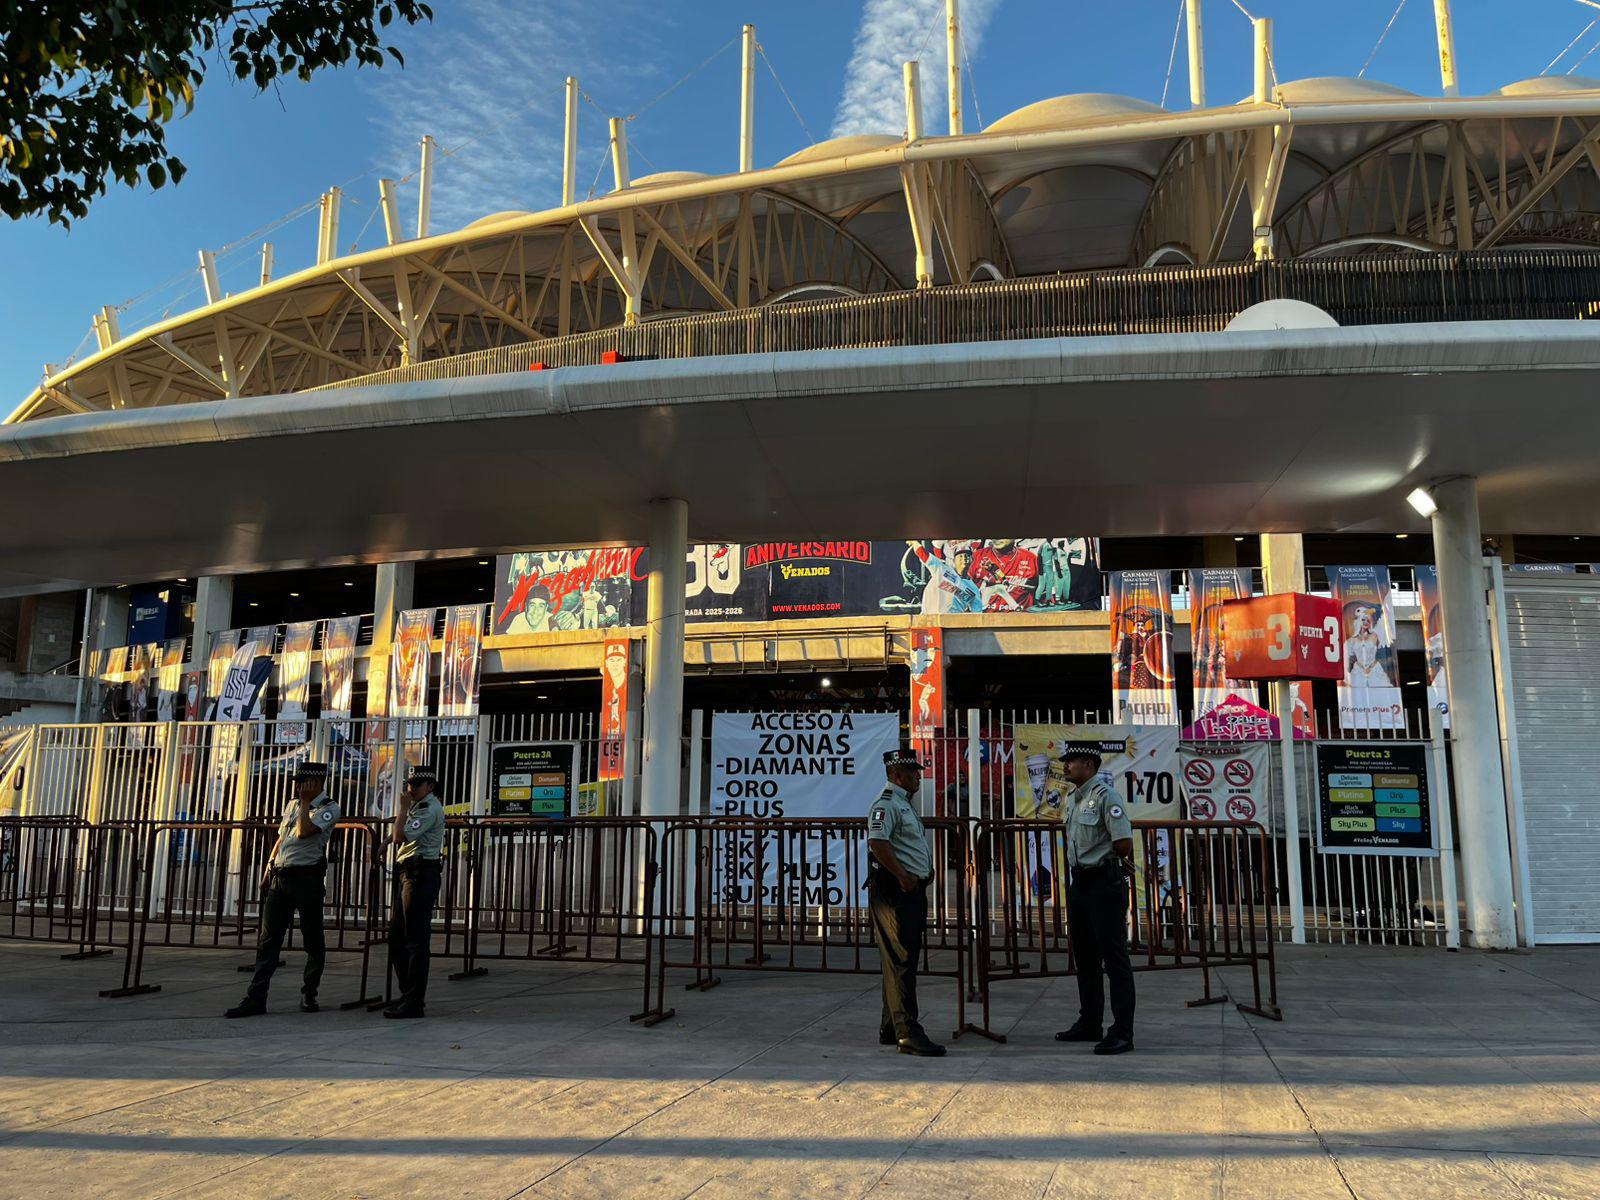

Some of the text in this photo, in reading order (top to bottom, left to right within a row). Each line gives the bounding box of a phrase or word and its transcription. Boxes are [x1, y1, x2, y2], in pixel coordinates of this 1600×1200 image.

[746, 541, 869, 567] ANIVERSARIO
[1121, 570, 1157, 578] CARNAVAL
[705, 607, 743, 615] 2025-2026
[772, 603, 841, 612] WWW.VENADOS.COM
[1267, 613, 1291, 660] 3
[1299, 616, 1340, 662] PUERTA 3
[751, 713, 853, 730] ACCESO A
[758, 734, 850, 755] ZONAS
[541, 750, 552, 758] 3A
[1346, 749, 1391, 758] Puerta 3
[716, 757, 855, 775] -DIAMANTE
[716, 780, 778, 798] -ORO
[1389, 806, 1406, 814] Plus
[1338, 820, 1368, 828] Sky Plus
[1392, 820, 1405, 830] Sky
